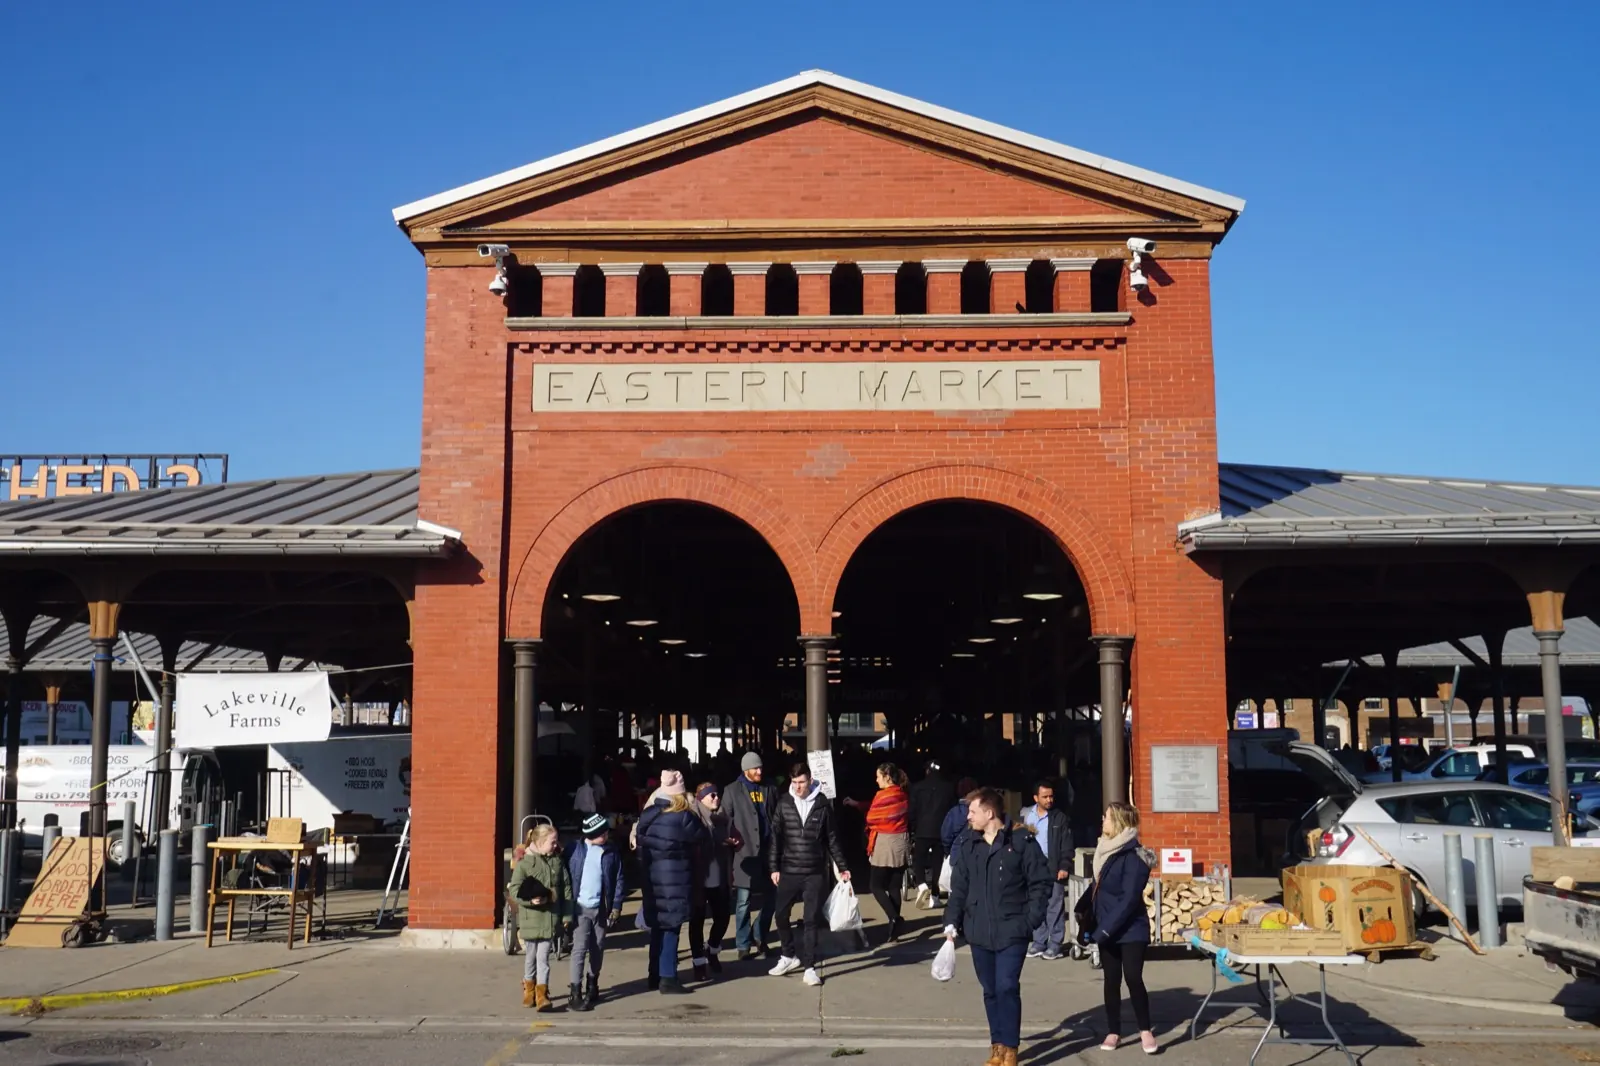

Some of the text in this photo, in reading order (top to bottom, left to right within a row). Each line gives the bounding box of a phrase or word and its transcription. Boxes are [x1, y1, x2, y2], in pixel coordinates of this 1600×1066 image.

[548, 369, 1083, 403] EASTERN MARKET
[203, 691, 306, 718] Lakeville
[230, 713, 281, 728] Farms
[40, 879, 88, 894] ORDER
[32, 893, 82, 909] HERE
